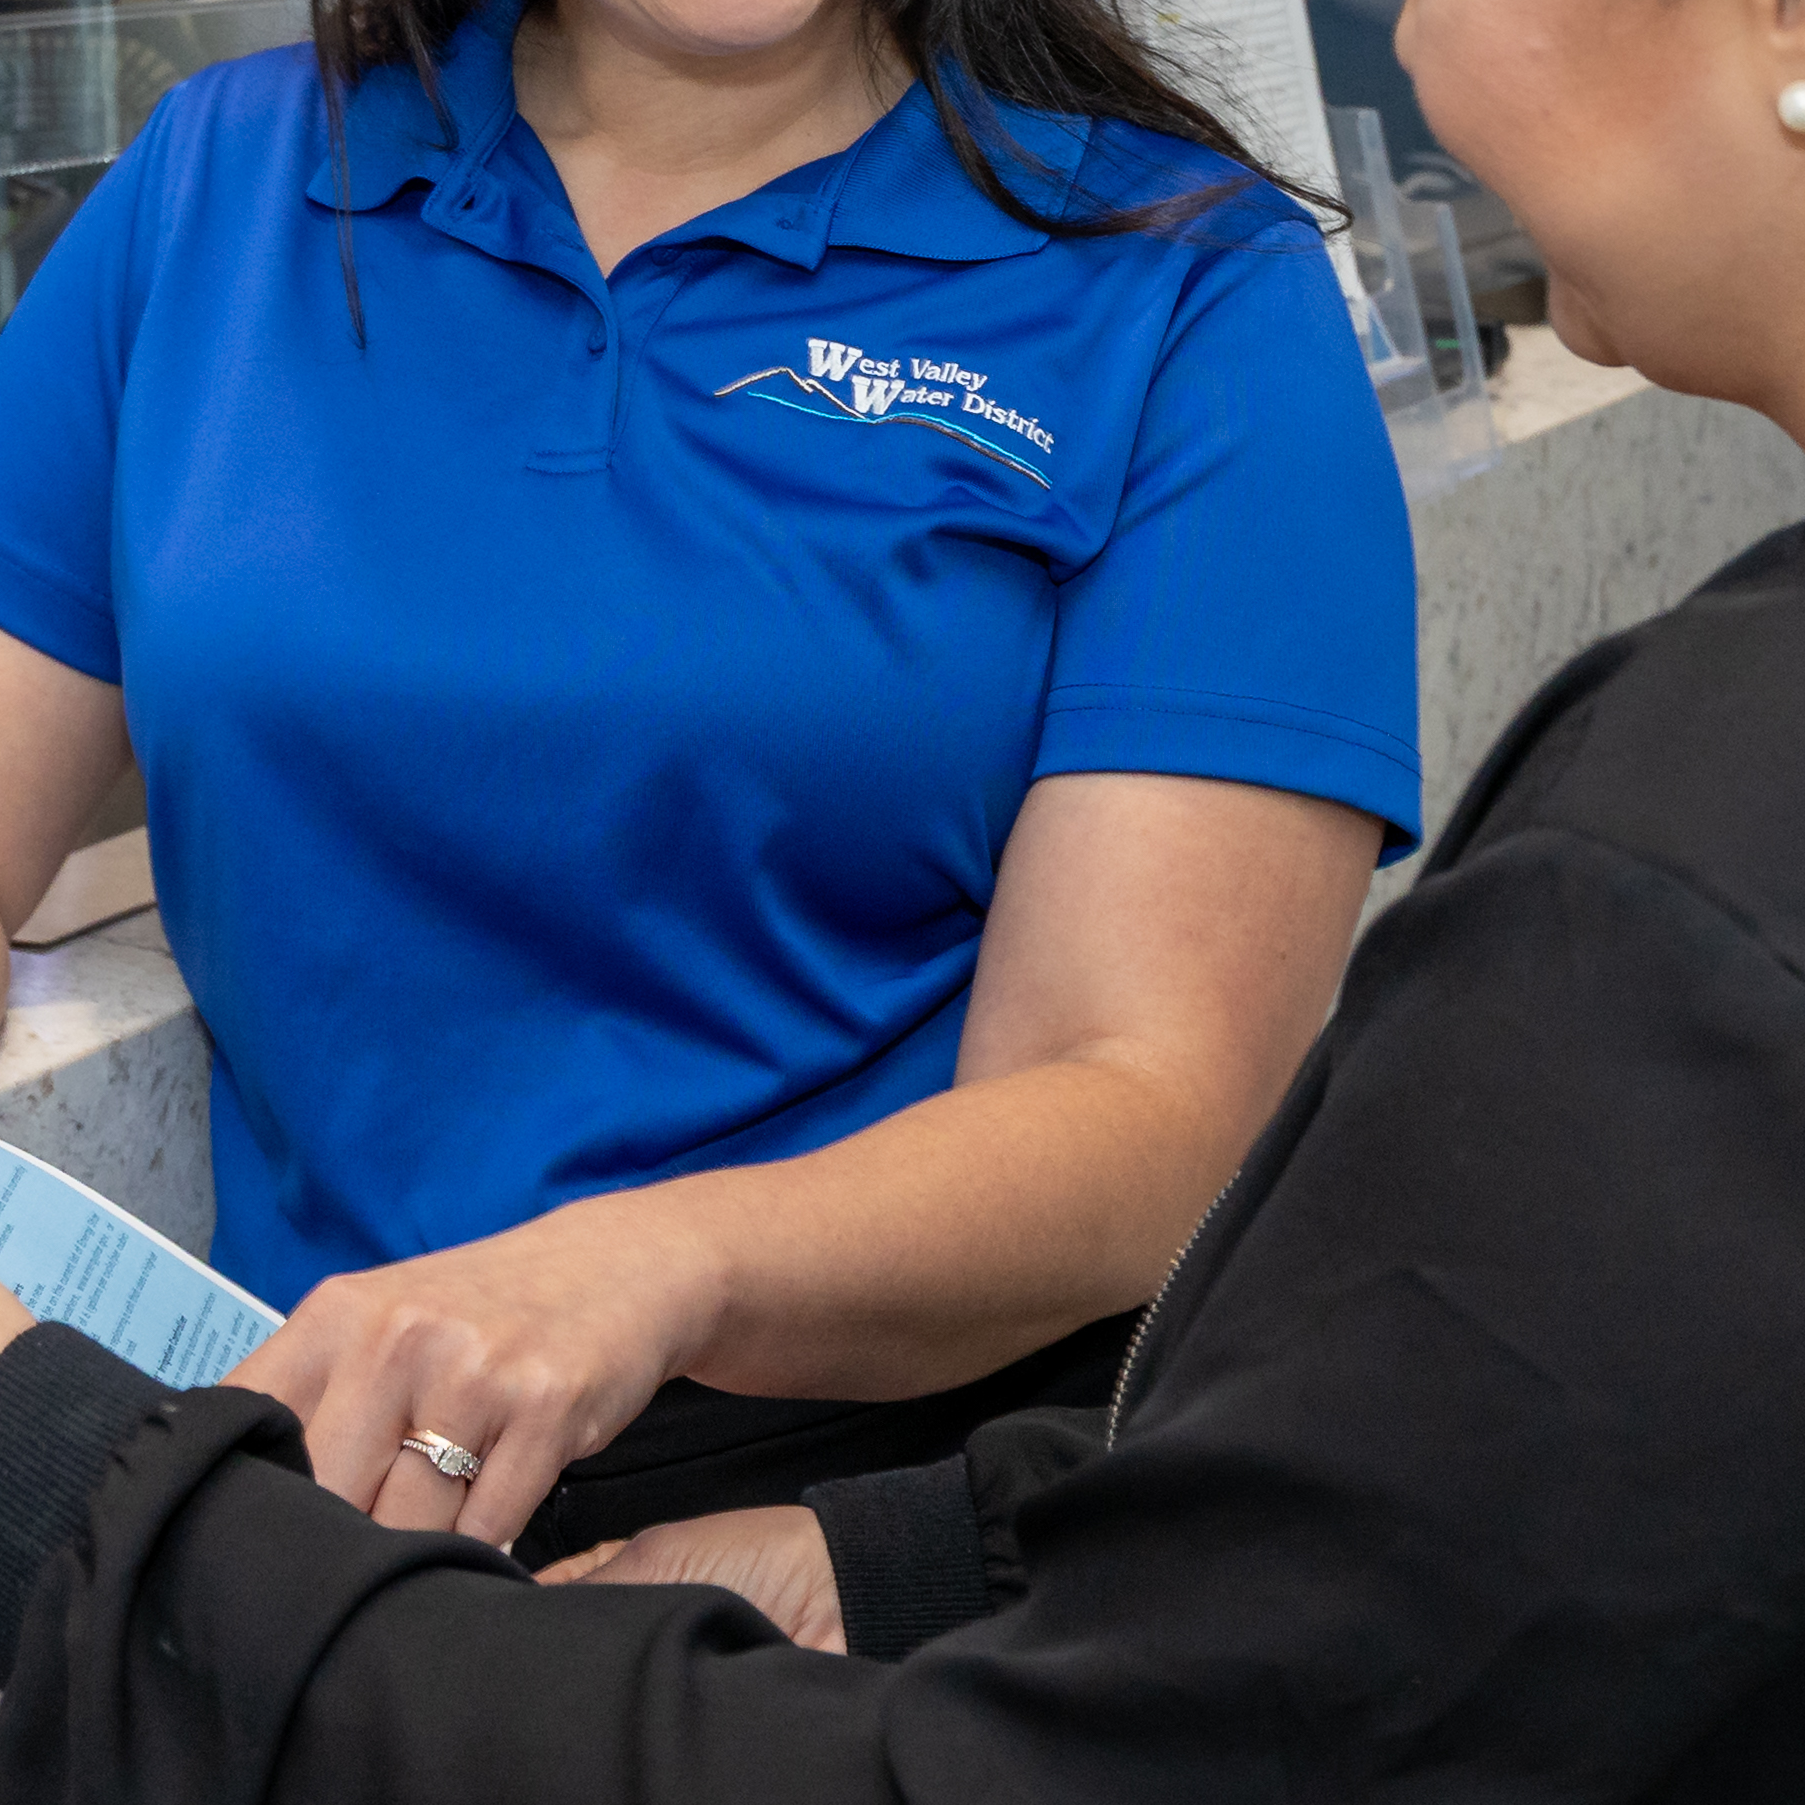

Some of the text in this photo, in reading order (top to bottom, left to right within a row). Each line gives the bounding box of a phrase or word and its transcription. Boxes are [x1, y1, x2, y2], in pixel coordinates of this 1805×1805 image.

[807, 337, 988, 392] West Valley
[851, 376, 1055, 455] Water District
